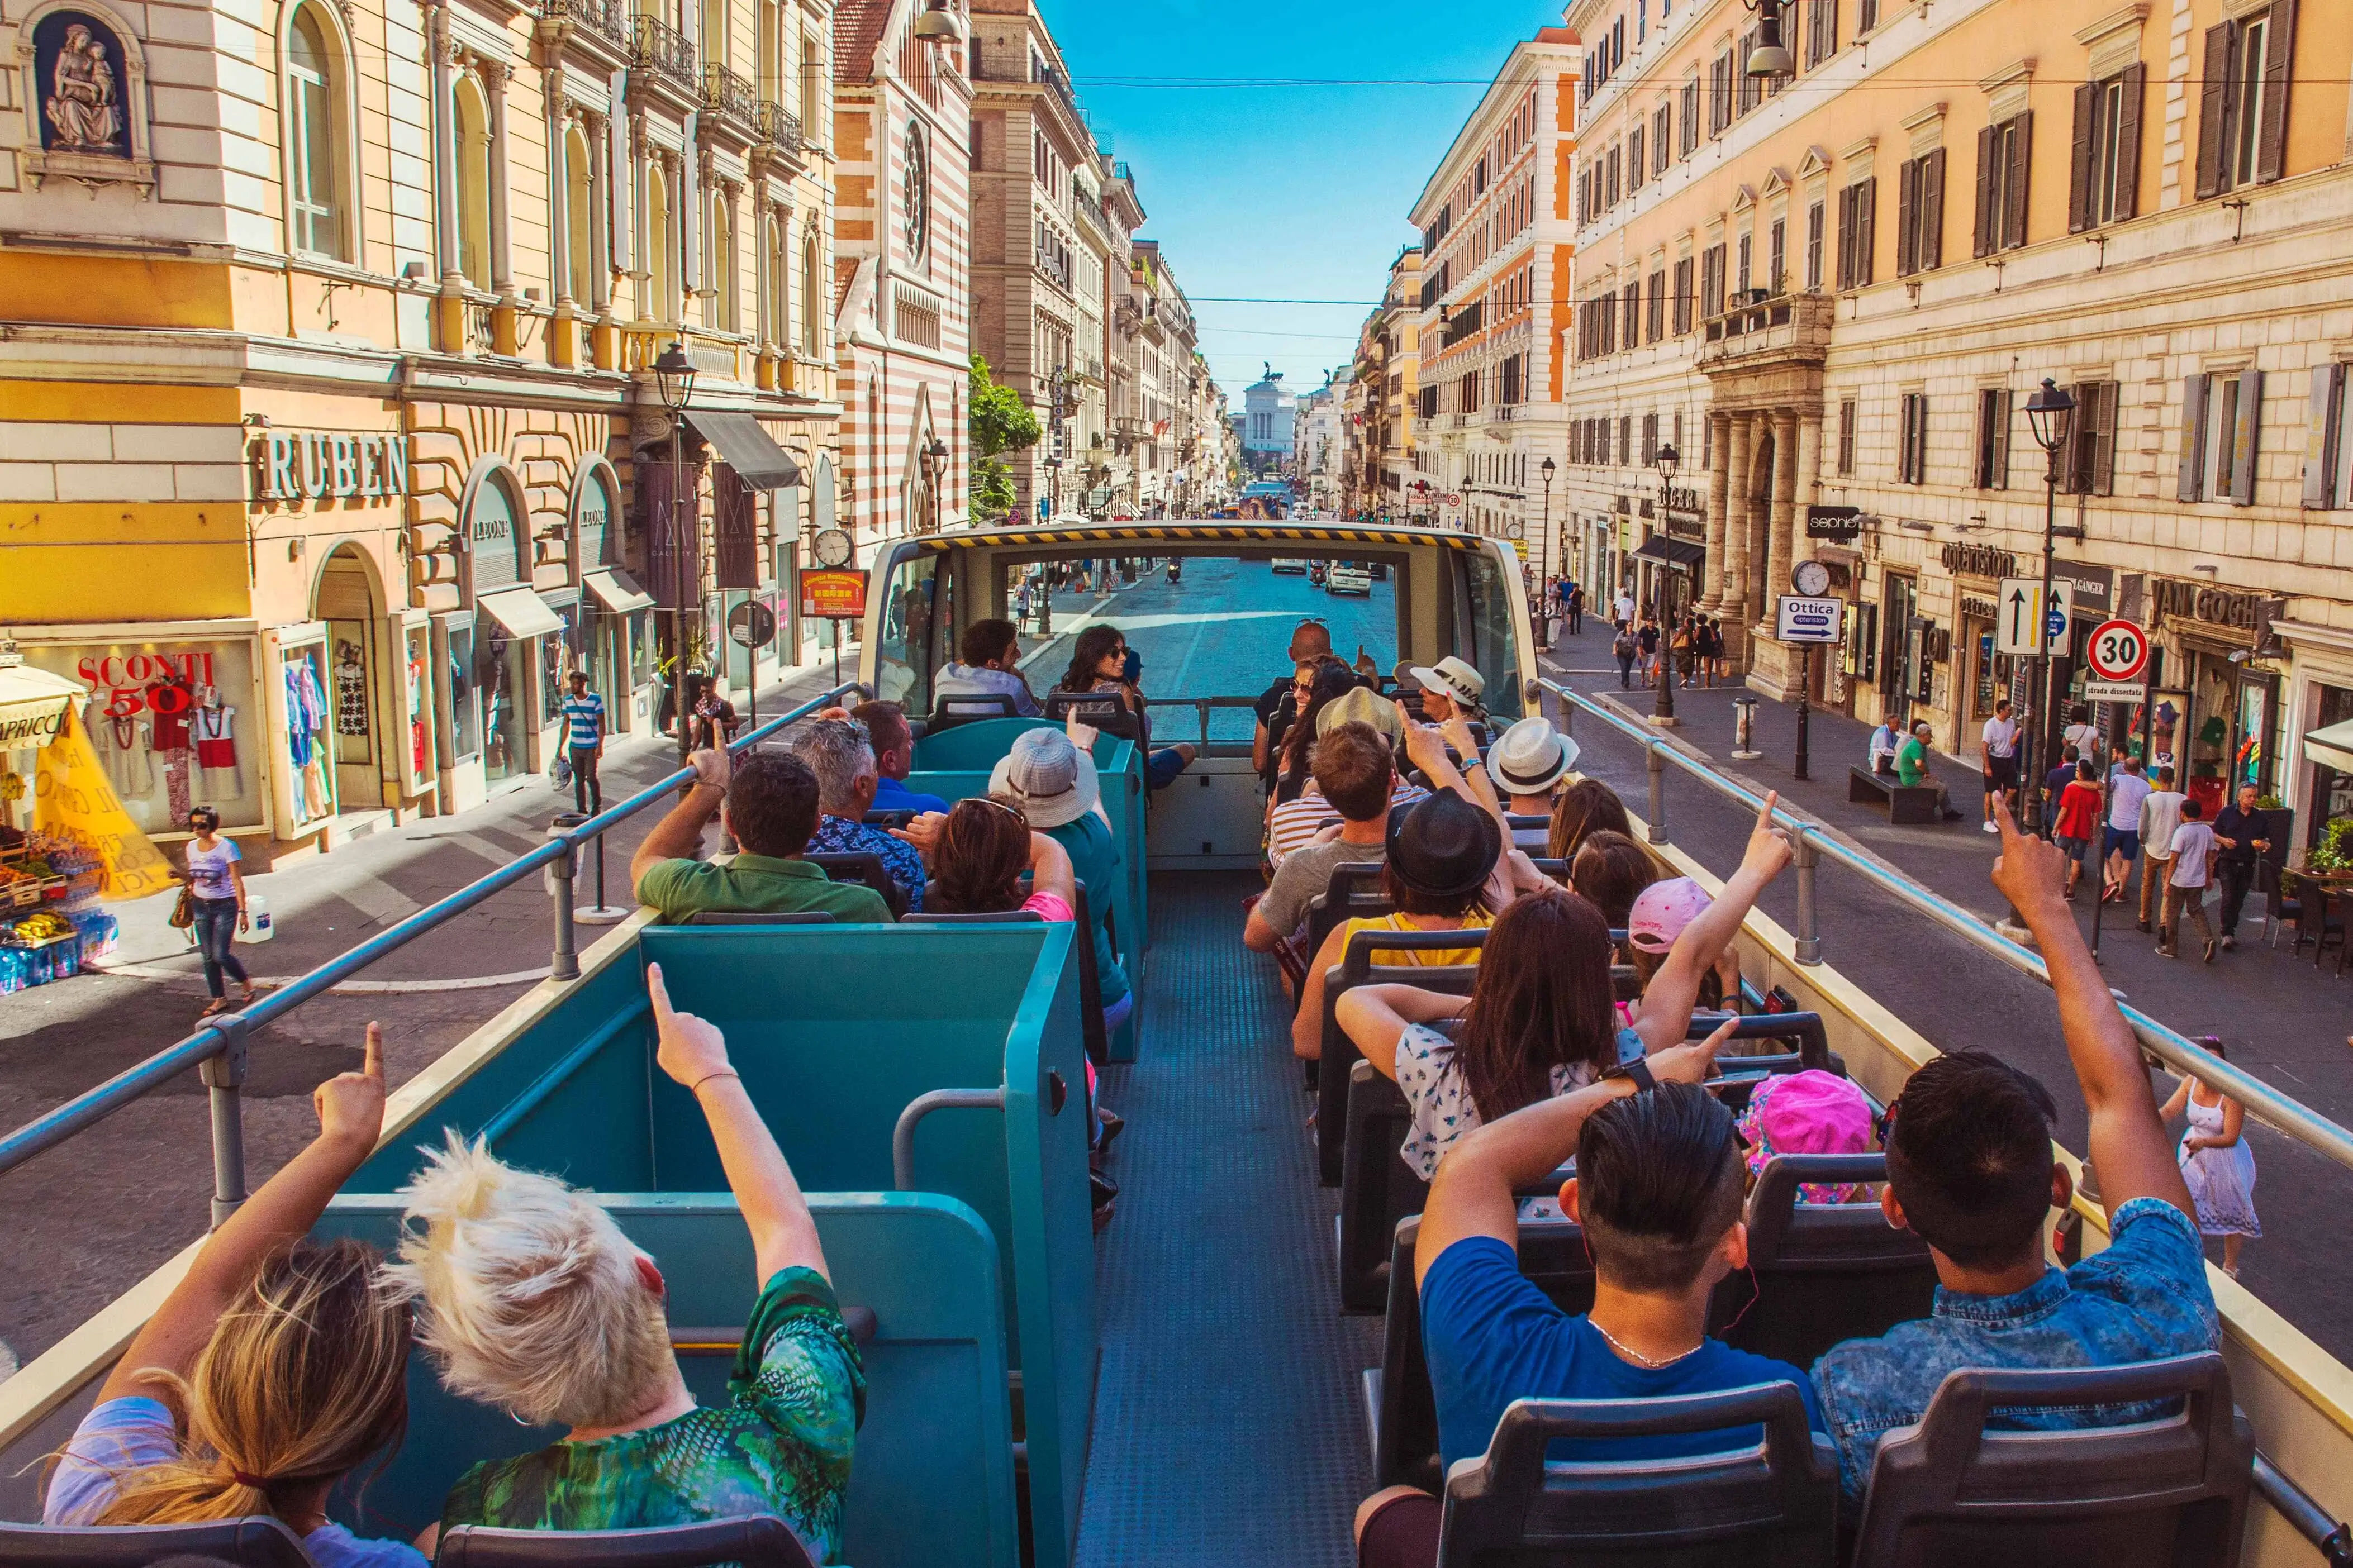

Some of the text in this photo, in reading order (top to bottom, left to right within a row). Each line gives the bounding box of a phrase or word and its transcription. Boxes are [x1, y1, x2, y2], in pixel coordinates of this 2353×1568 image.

[267, 432, 408, 498] RUBEN
[474, 520, 509, 541] LEONE
[581, 510, 606, 527] LEONE
[1789, 603, 1833, 614] Ottica
[2197, 589, 2259, 630] GOGH
[2102, 636, 2136, 664] 30
[78, 652, 214, 693] SCONTI
[103, 686, 191, 717] 50
